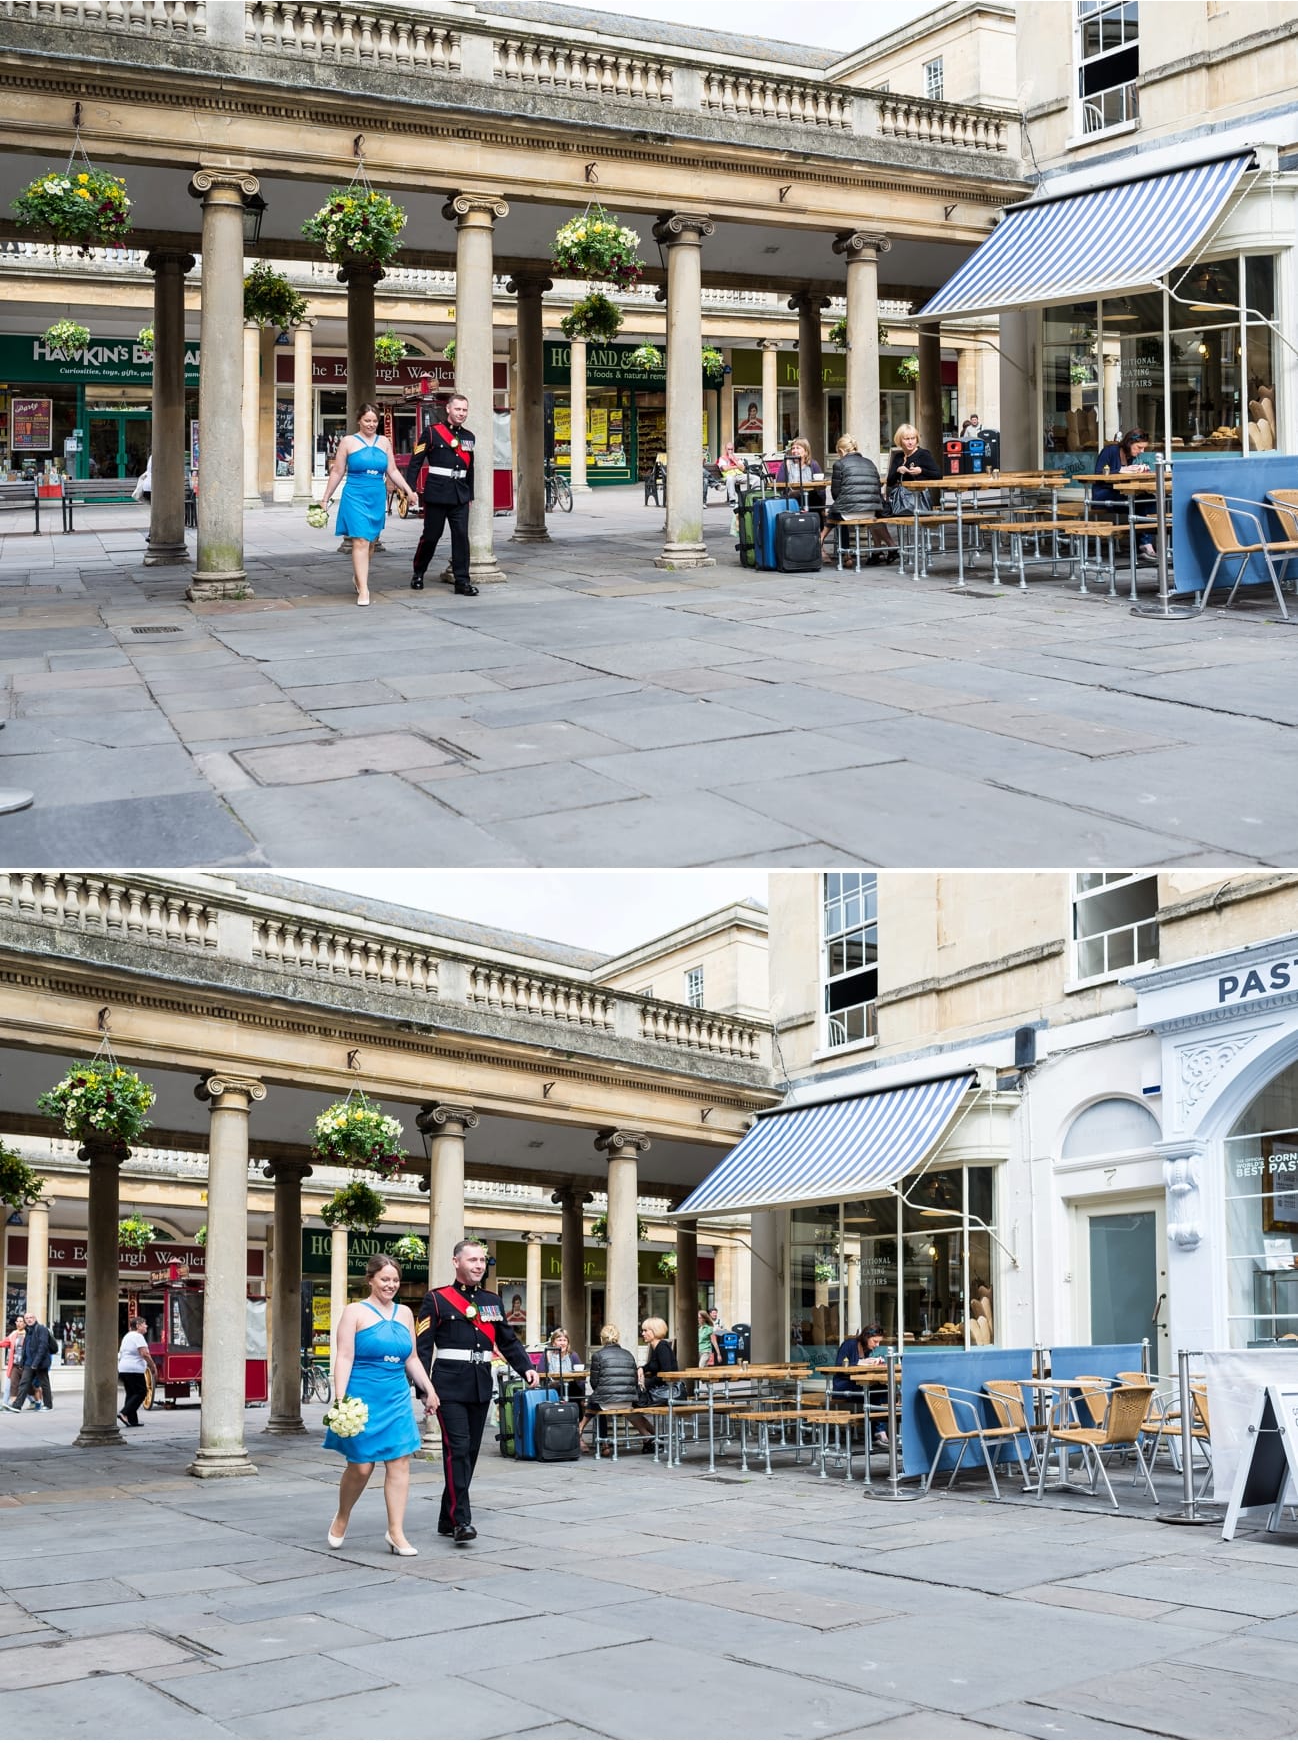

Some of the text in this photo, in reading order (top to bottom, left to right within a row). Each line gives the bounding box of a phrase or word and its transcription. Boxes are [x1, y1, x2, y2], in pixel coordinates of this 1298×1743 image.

[552, 348, 618, 366] HOAND
[103, 369, 120, 377] toys,
[312, 362, 328, 376] he
[593, 369, 613, 378] foods
[615, 370, 621, 378] &
[624, 371, 648, 379] natural
[1218, 959, 1298, 1003] PAS
[1268, 1152, 1298, 1163] CORN
[1236, 1166, 1265, 1177] BEST
[1268, 1160, 1298, 1174] PAS
[1103, 1168, 1118, 1187] 7
[49, 1245, 65, 1259] he
[311, 1235, 380, 1255] HOAND
